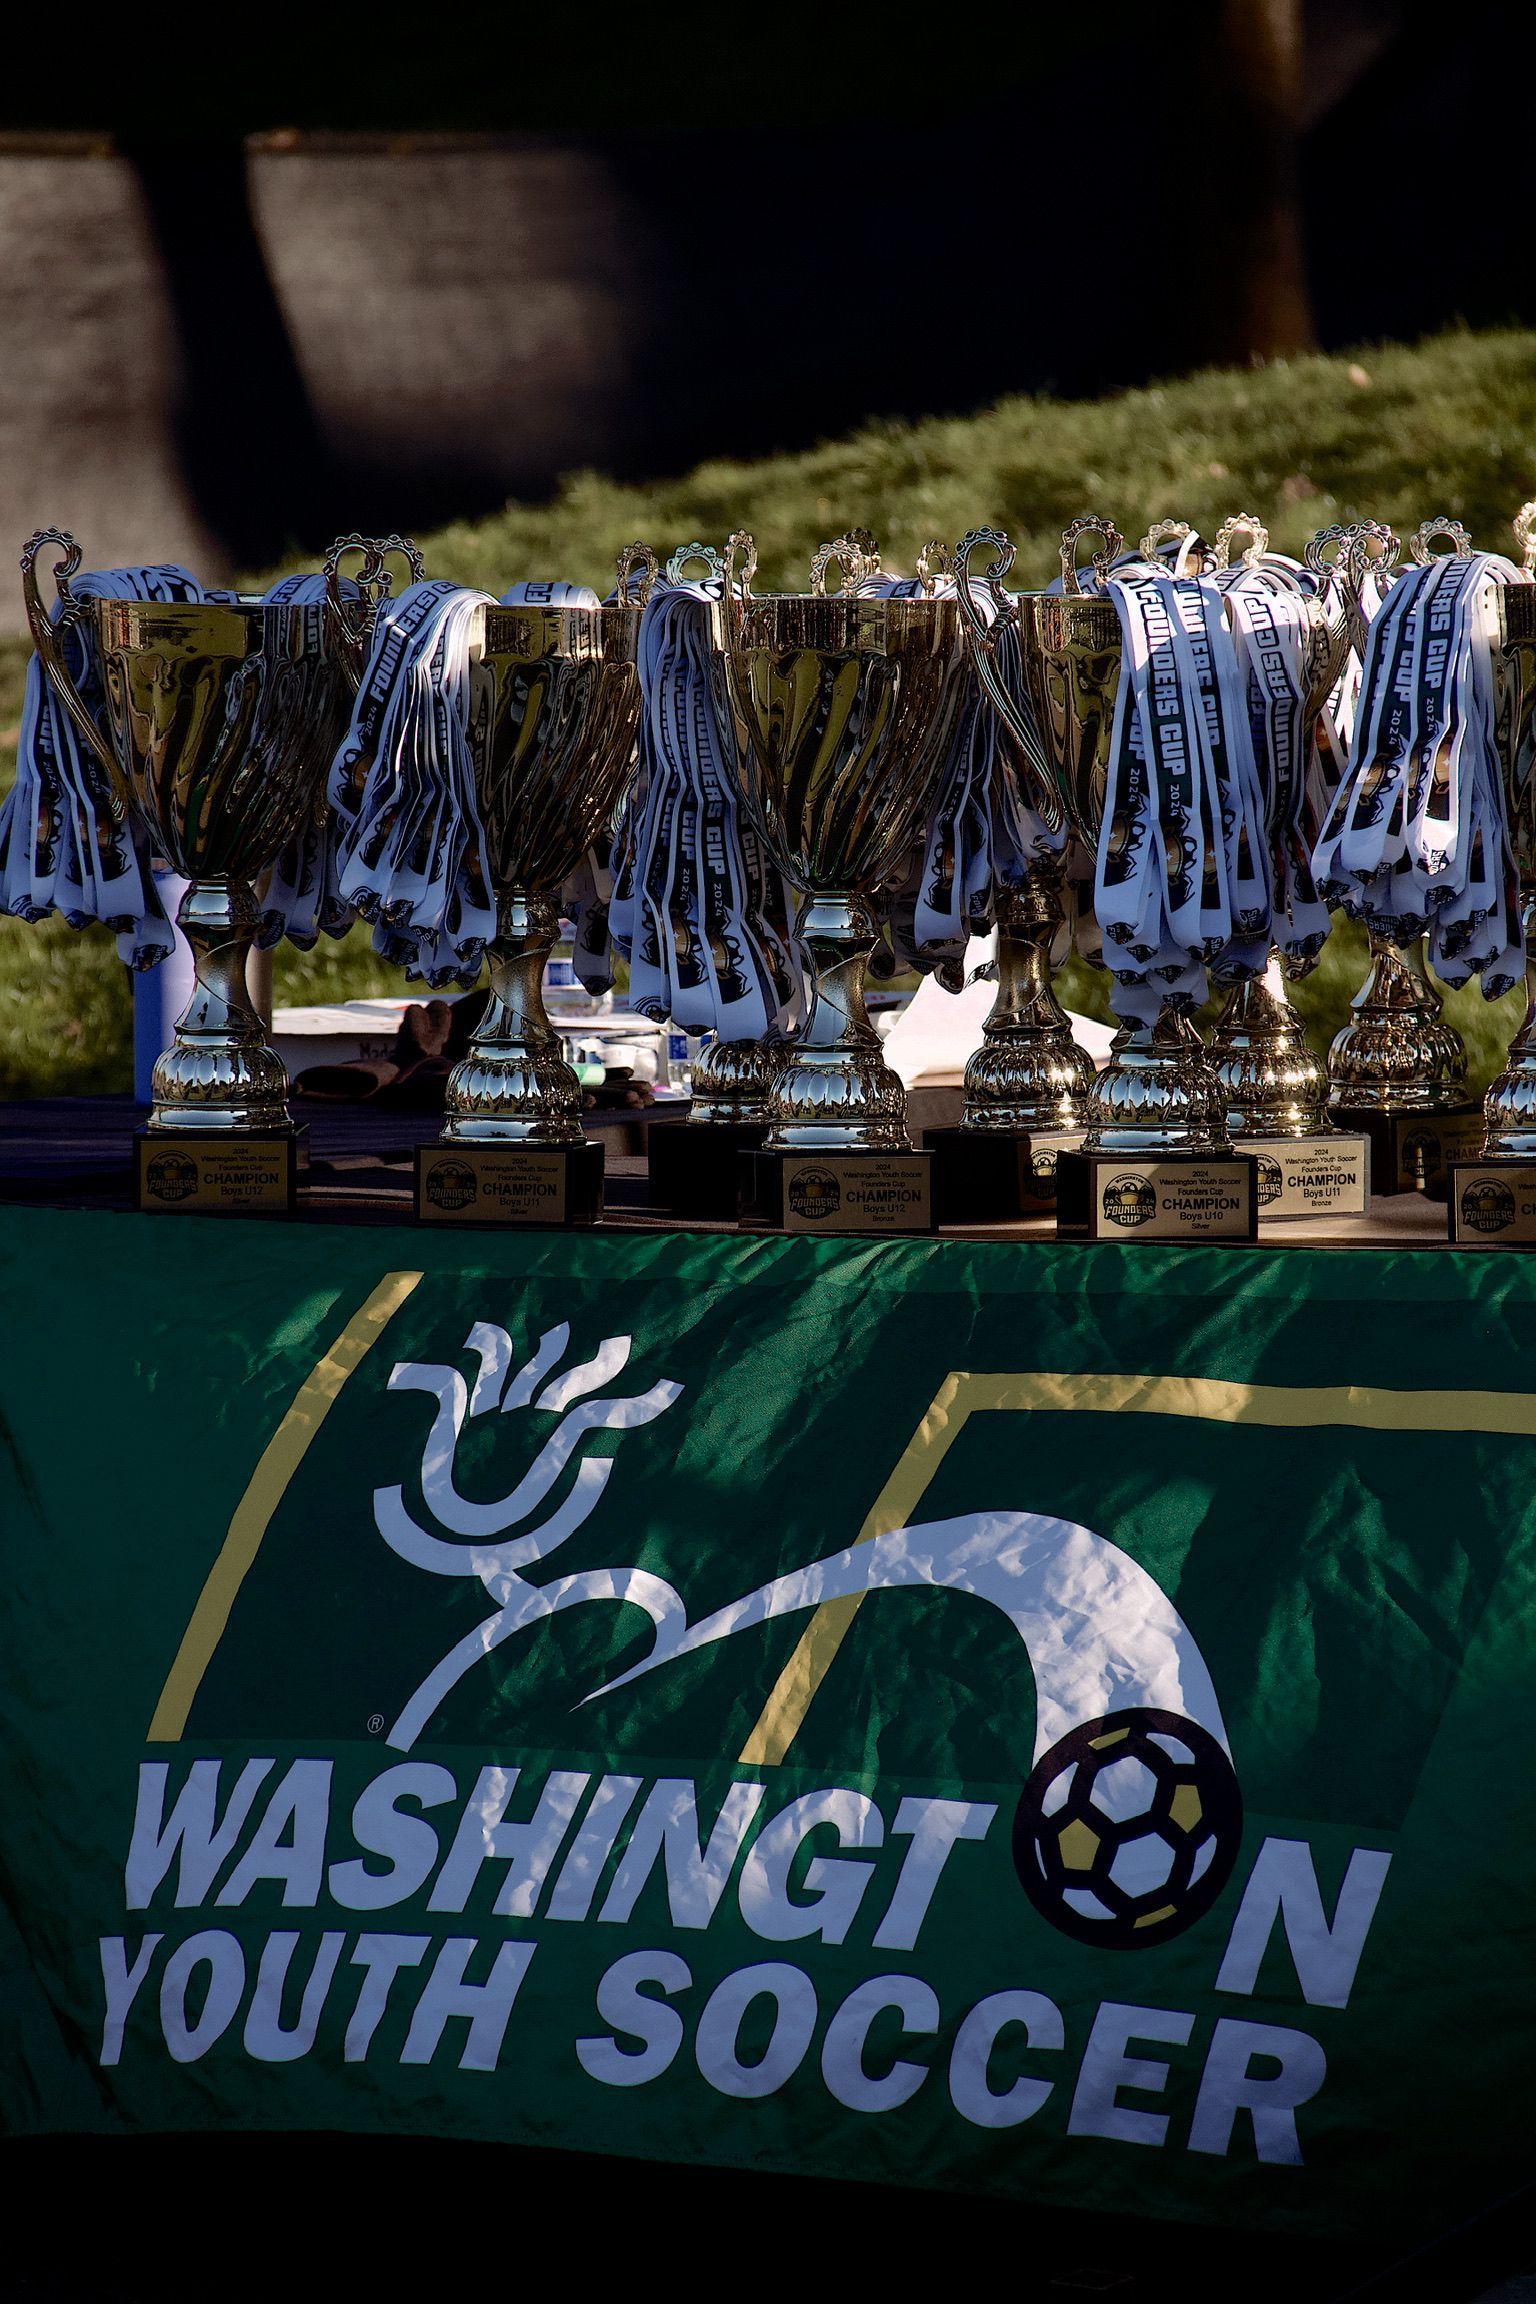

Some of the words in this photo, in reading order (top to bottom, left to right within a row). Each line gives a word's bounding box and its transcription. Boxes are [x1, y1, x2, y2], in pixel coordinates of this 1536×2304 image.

[1243, 597, 1281, 648] CUP
[369, 590, 440, 704] FOUNDERS
[1136, 590, 1182, 717] FOUNDERS
[1425, 638, 1448, 689] CUP
[1261, 651, 1294, 783] FOUNDERS
[1426, 697, 1435, 732] 2024
[365, 706, 378, 737] 2024
[1389, 709, 1403, 745] 2024
[1158, 721, 1187, 777] CUP
[1128, 767, 1141, 803] 2024
[1170, 783, 1182, 818] 2024
[680, 810, 698, 862] CUP
[706, 826, 726, 875] CUP
[742, 831, 760, 881] CUP
[681, 867, 691, 901] 2024
[713, 882, 723, 917] 2024
[200, 1155, 238, 1163] Washington
[511, 1157, 528, 1165] 2024
[1285, 1157, 1319, 1165] Washington
[480, 1165, 518, 1173] Washington
[519, 1165, 536, 1173] Youth
[203, 1172, 280, 1185] CHAMPION
[843, 1172, 880, 1180] Washington
[1160, 1178, 1198, 1186] Washington
[1287, 1173, 1356, 1187] CHAMPION
[220, 1186, 243, 1197] Boys
[244, 1186, 264, 1196] U12
[482, 1183, 557, 1196] CHAMPION
[892, 1181, 906, 1189] Cup
[162, 1187, 184, 1199] CUP
[429, 1188, 476, 1202] FOUNDERS
[846, 1190, 922, 1203] CHAMPION
[1209, 1188, 1224, 1196] Cup
[1303, 1188, 1324, 1199] Boys
[1325, 1187, 1341, 1197] U11
[442, 1198, 462, 1208] CUP
[500, 1198, 522, 1207] Boys
[523, 1198, 540, 1207] U11
[791, 1198, 840, 1211] FOUNDERS
[863, 1204, 885, 1214] Boys
[887, 1204, 906, 1213] U12
[1162, 1198, 1240, 1210] CHAMPION
[804, 1207, 825, 1216] CUP
[1105, 1205, 1155, 1217] FOUNDERS
[1180, 1212, 1202, 1222] Boys
[1205, 1211, 1223, 1220] U10
[1464, 1210, 1515, 1224] FOUNDERS
[1119, 1215, 1141, 1223] CUP
[1480, 1220, 1500, 1229] CUP
[98, 1928, 538, 2073] YOUTH
[574, 1948, 1327, 2167] SOCCER
